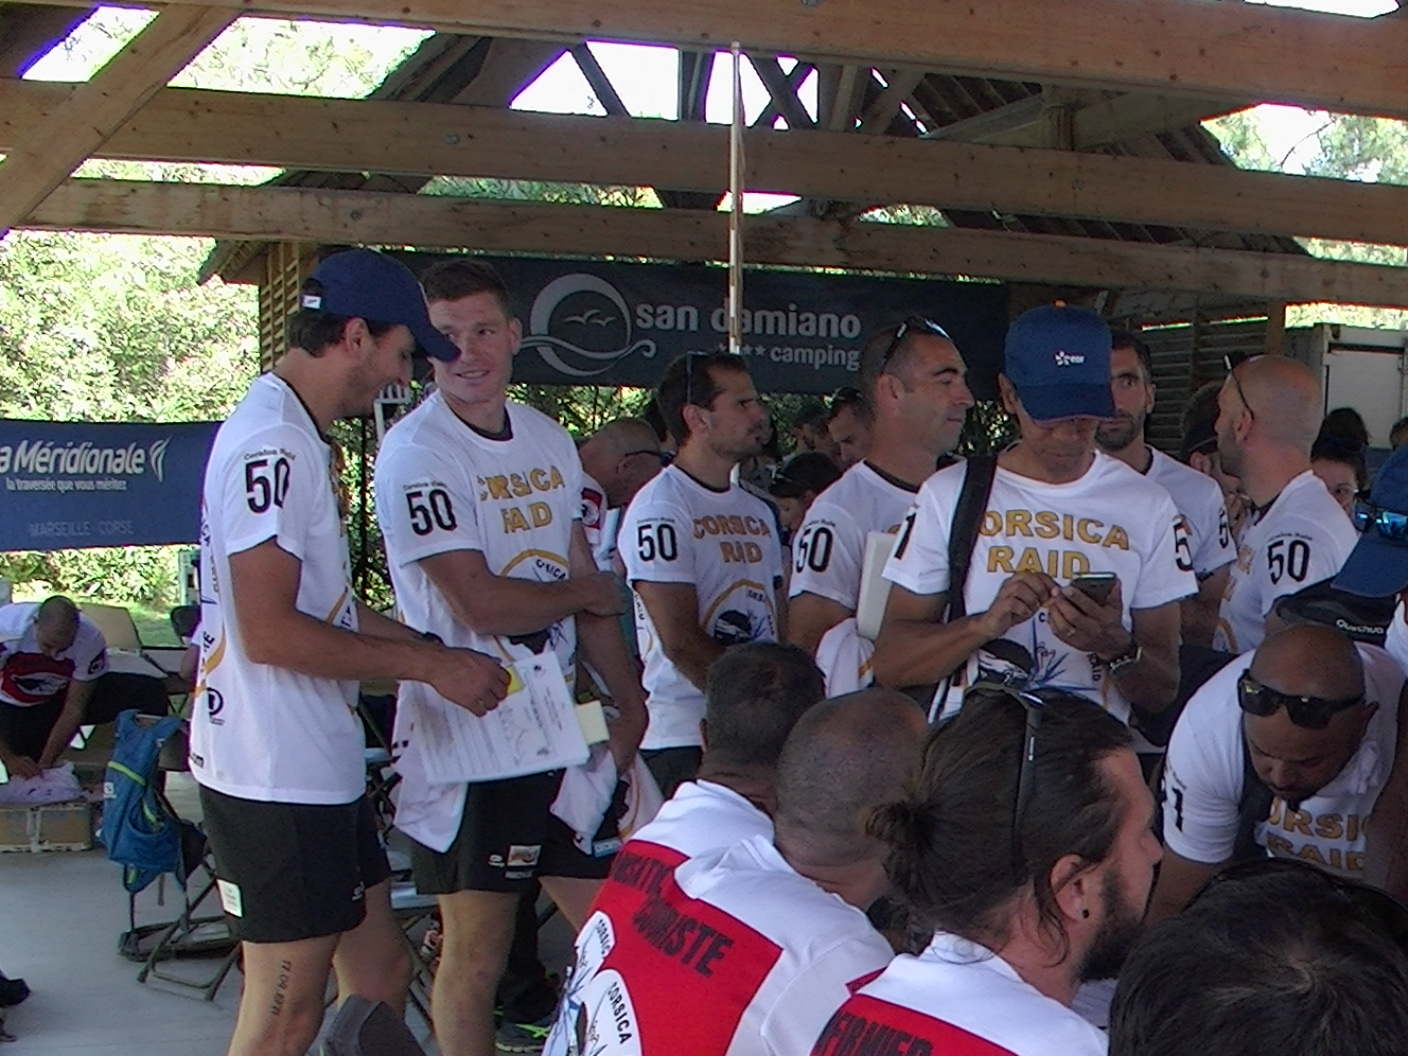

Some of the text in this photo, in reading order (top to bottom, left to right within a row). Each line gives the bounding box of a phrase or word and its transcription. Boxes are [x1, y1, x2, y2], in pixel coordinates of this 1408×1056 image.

[636, 303, 698, 331] san
[770, 346, 859, 371] camping
[14, 440, 146, 475] Méridionale
[57, 480, 74, 494] que
[75, 479, 94, 491] vous
[246, 458, 290, 513] 50
[30, 520, 134, 537] MARSEILLE CORSE
[406, 489, 457, 535] 50
[638, 524, 678, 561] 50
[986, 546, 1091, 580] RAID
[1267, 539, 1311, 584] 50
